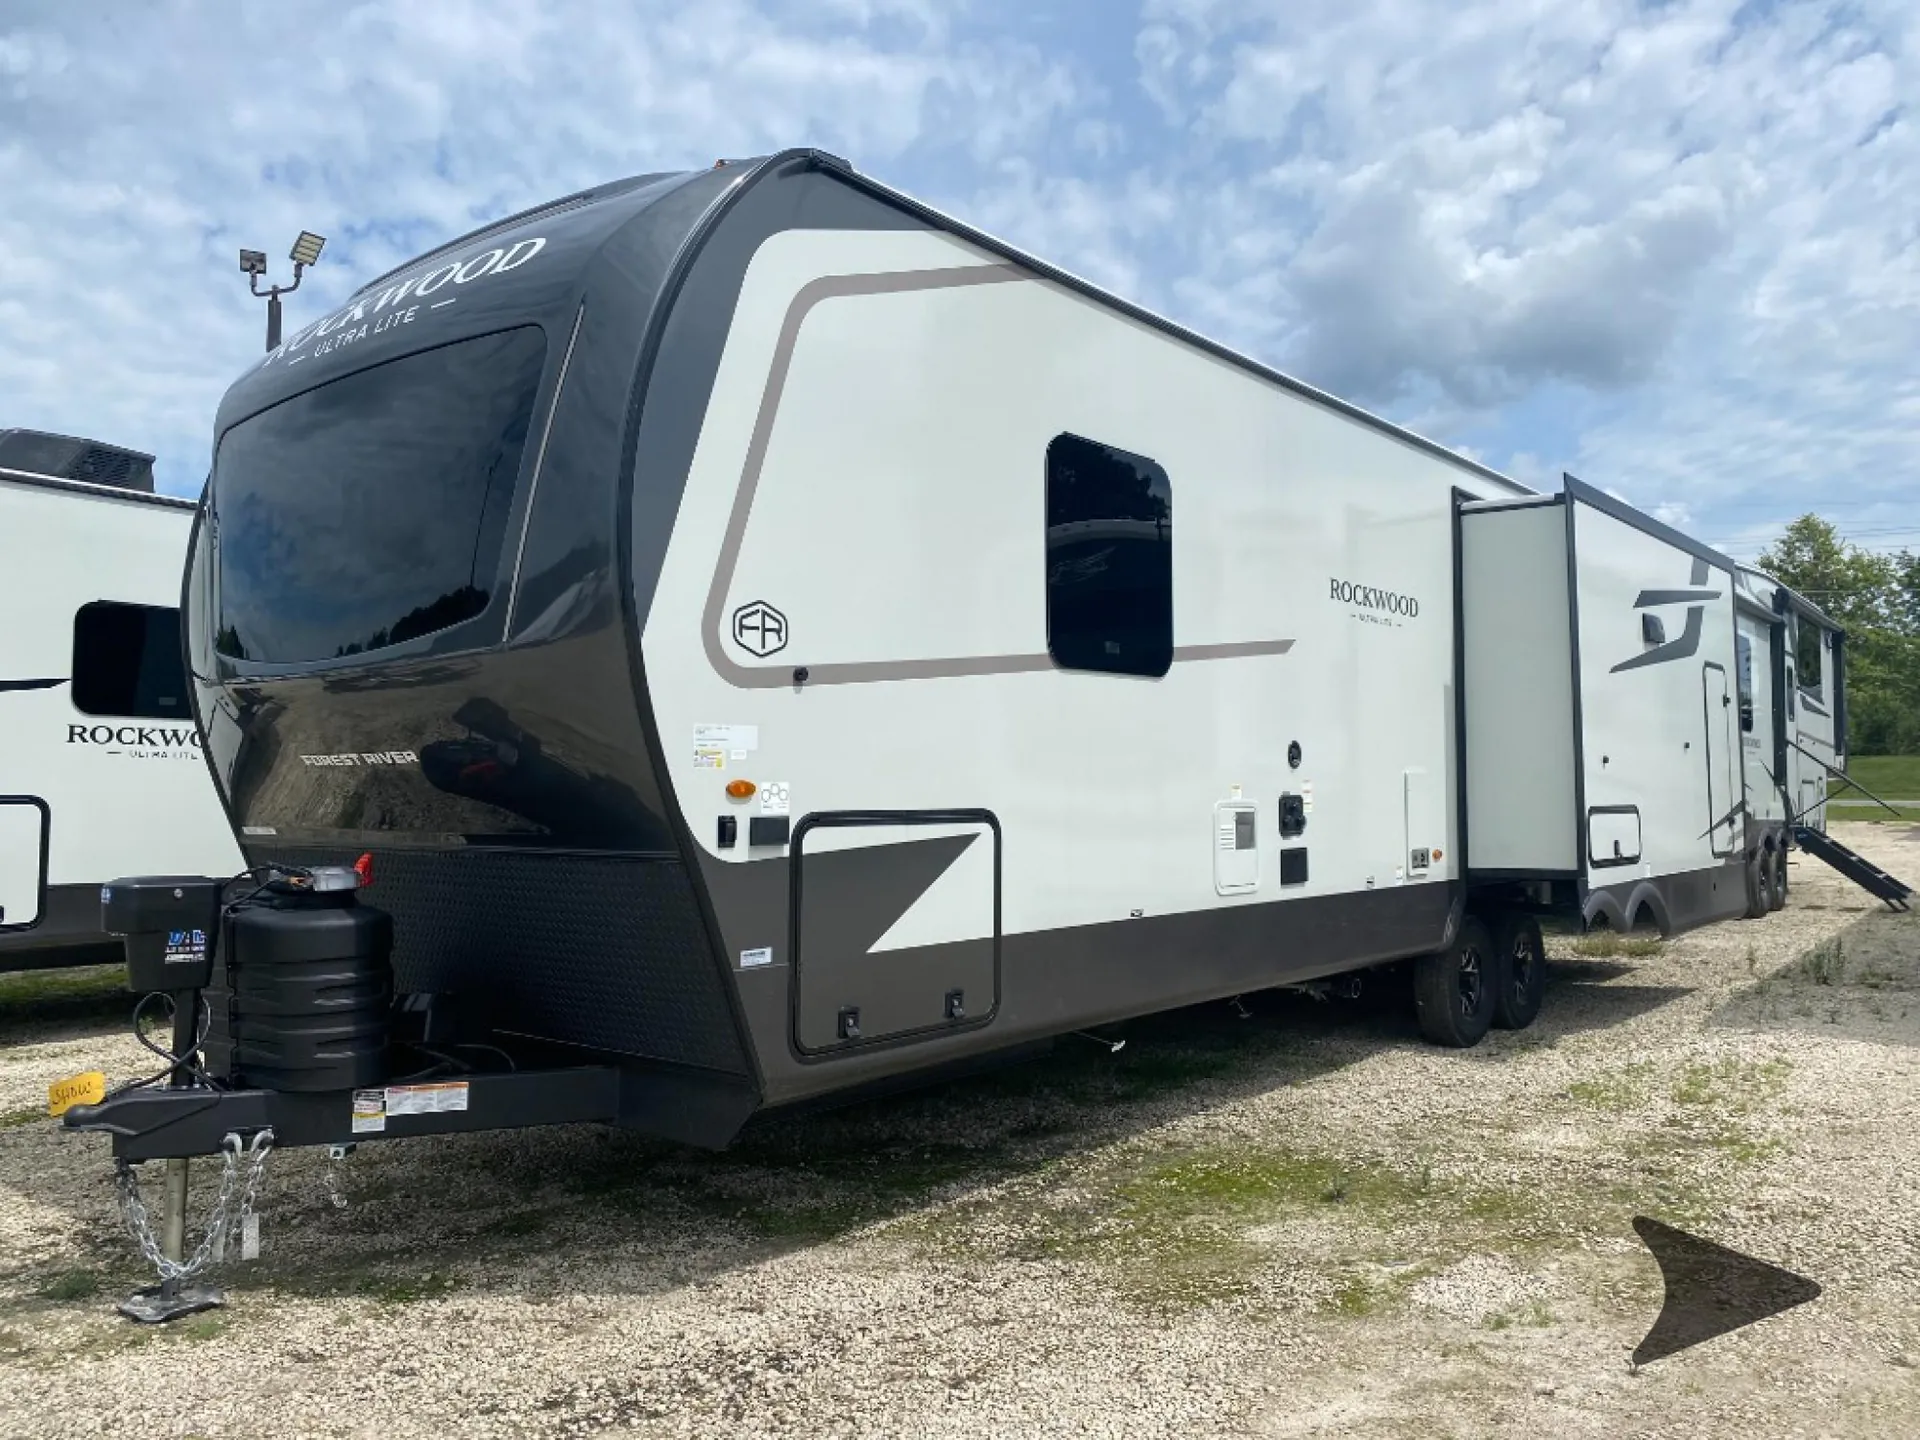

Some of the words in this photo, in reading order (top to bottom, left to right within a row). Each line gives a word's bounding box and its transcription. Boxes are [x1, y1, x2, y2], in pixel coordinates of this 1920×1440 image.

[314, 324, 368, 358] ULTRA
[374, 304, 420, 334] LITE
[1329, 577, 1418, 617] ROCKWOOD
[66, 724, 201, 748] ROCKWO
[300, 754, 360, 766] FOREST
[361, 751, 420, 764] RIVER
